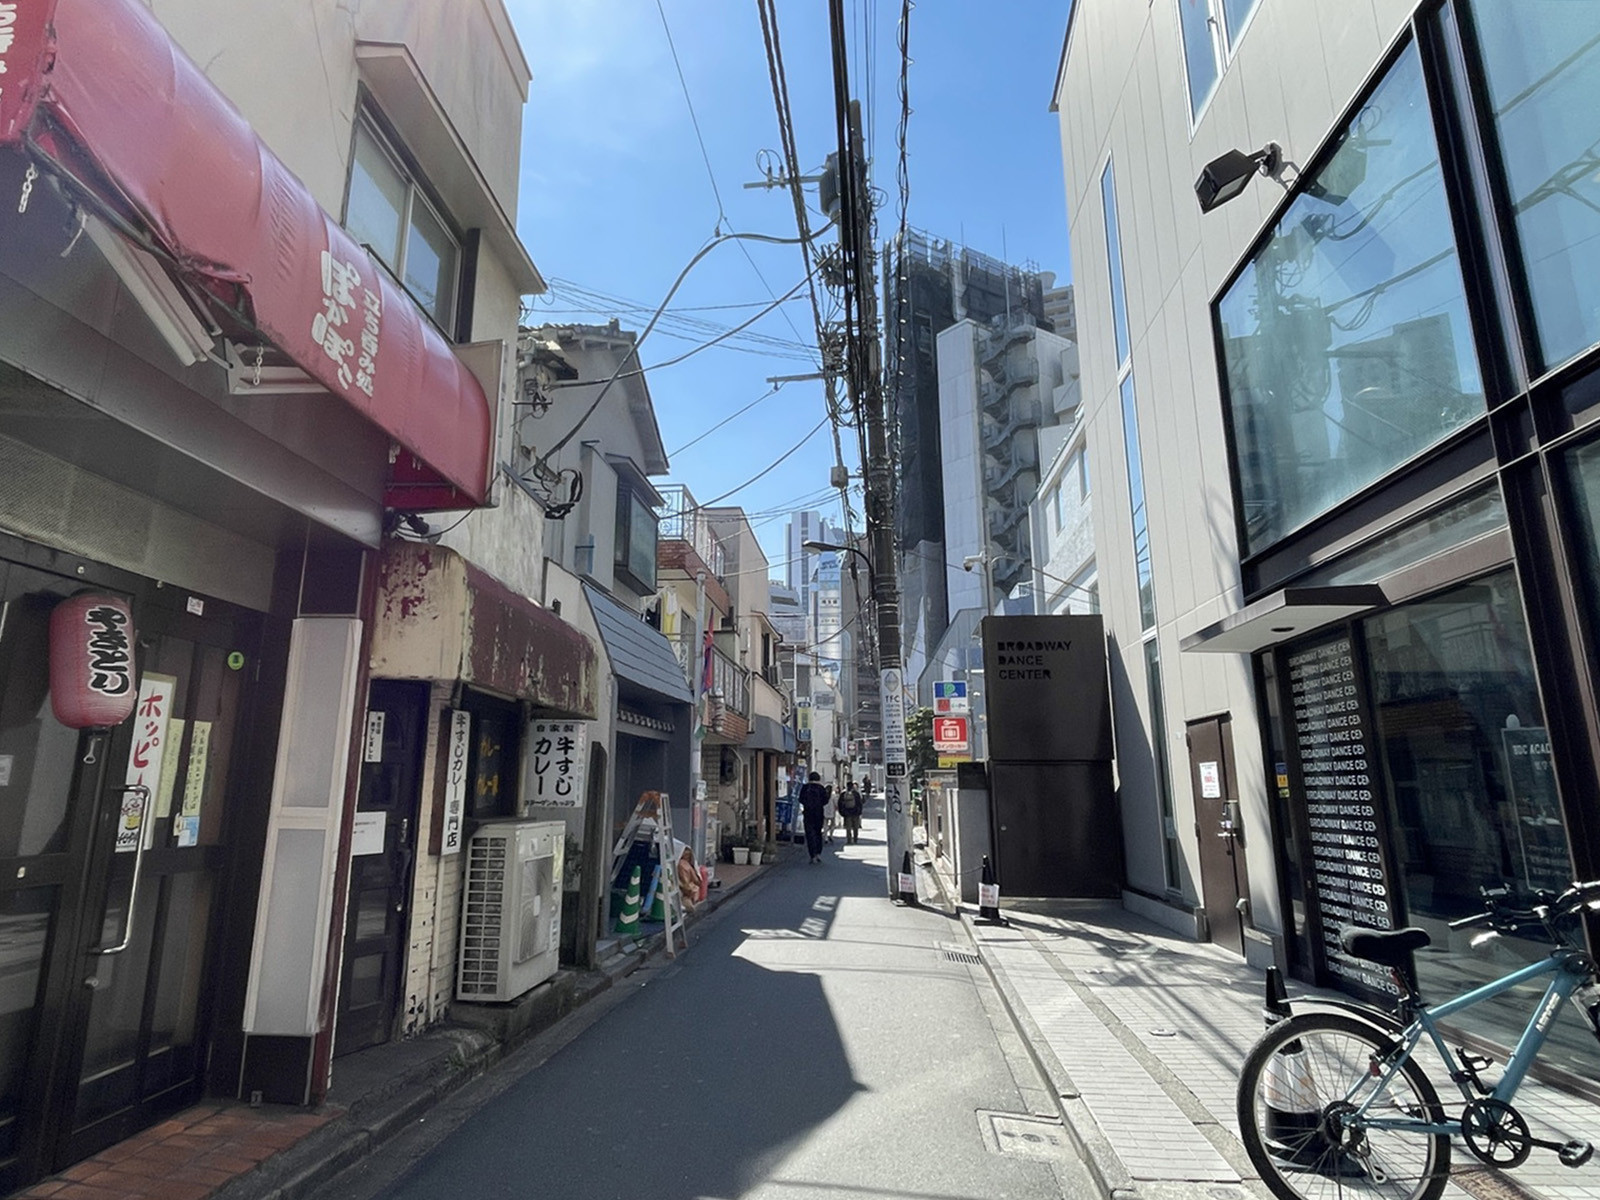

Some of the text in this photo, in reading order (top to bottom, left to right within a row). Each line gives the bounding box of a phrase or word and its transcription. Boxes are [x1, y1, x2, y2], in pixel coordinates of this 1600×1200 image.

[87, 606, 130, 695] やきとり
[997, 641, 1072, 651] BROADWAY
[998, 655, 1044, 665] DANCE
[999, 669, 1052, 680] CENTER
[1327, 717, 1348, 727] DANCE
[134, 687, 163, 796] ホッピー
[1329, 731, 1350, 741] DANCE
[1331, 746, 1352, 755] DANCE
[534, 737, 552, 796] カレー
[555, 736, 574, 796] 牛すじ
[1332, 761, 1354, 770] DANCE
[446, 712, 467, 847] 牛すじカレー専門店
[1334, 775, 1356, 784] DANCE
[1336, 790, 1358, 799] DANCE
[1338, 805, 1360, 814] DANCE
[1340, 820, 1362, 829] DANCE
[1342, 835, 1364, 845] DANCE
[1344, 849, 1366, 860] DANCE
[1346, 864, 1369, 876] DANCE
[1348, 880, 1371, 892] DANCE
[1350, 895, 1373, 908] DANCE
[1352, 910, 1375, 924] DANCE
[1361, 972, 1384, 989] DANCE
